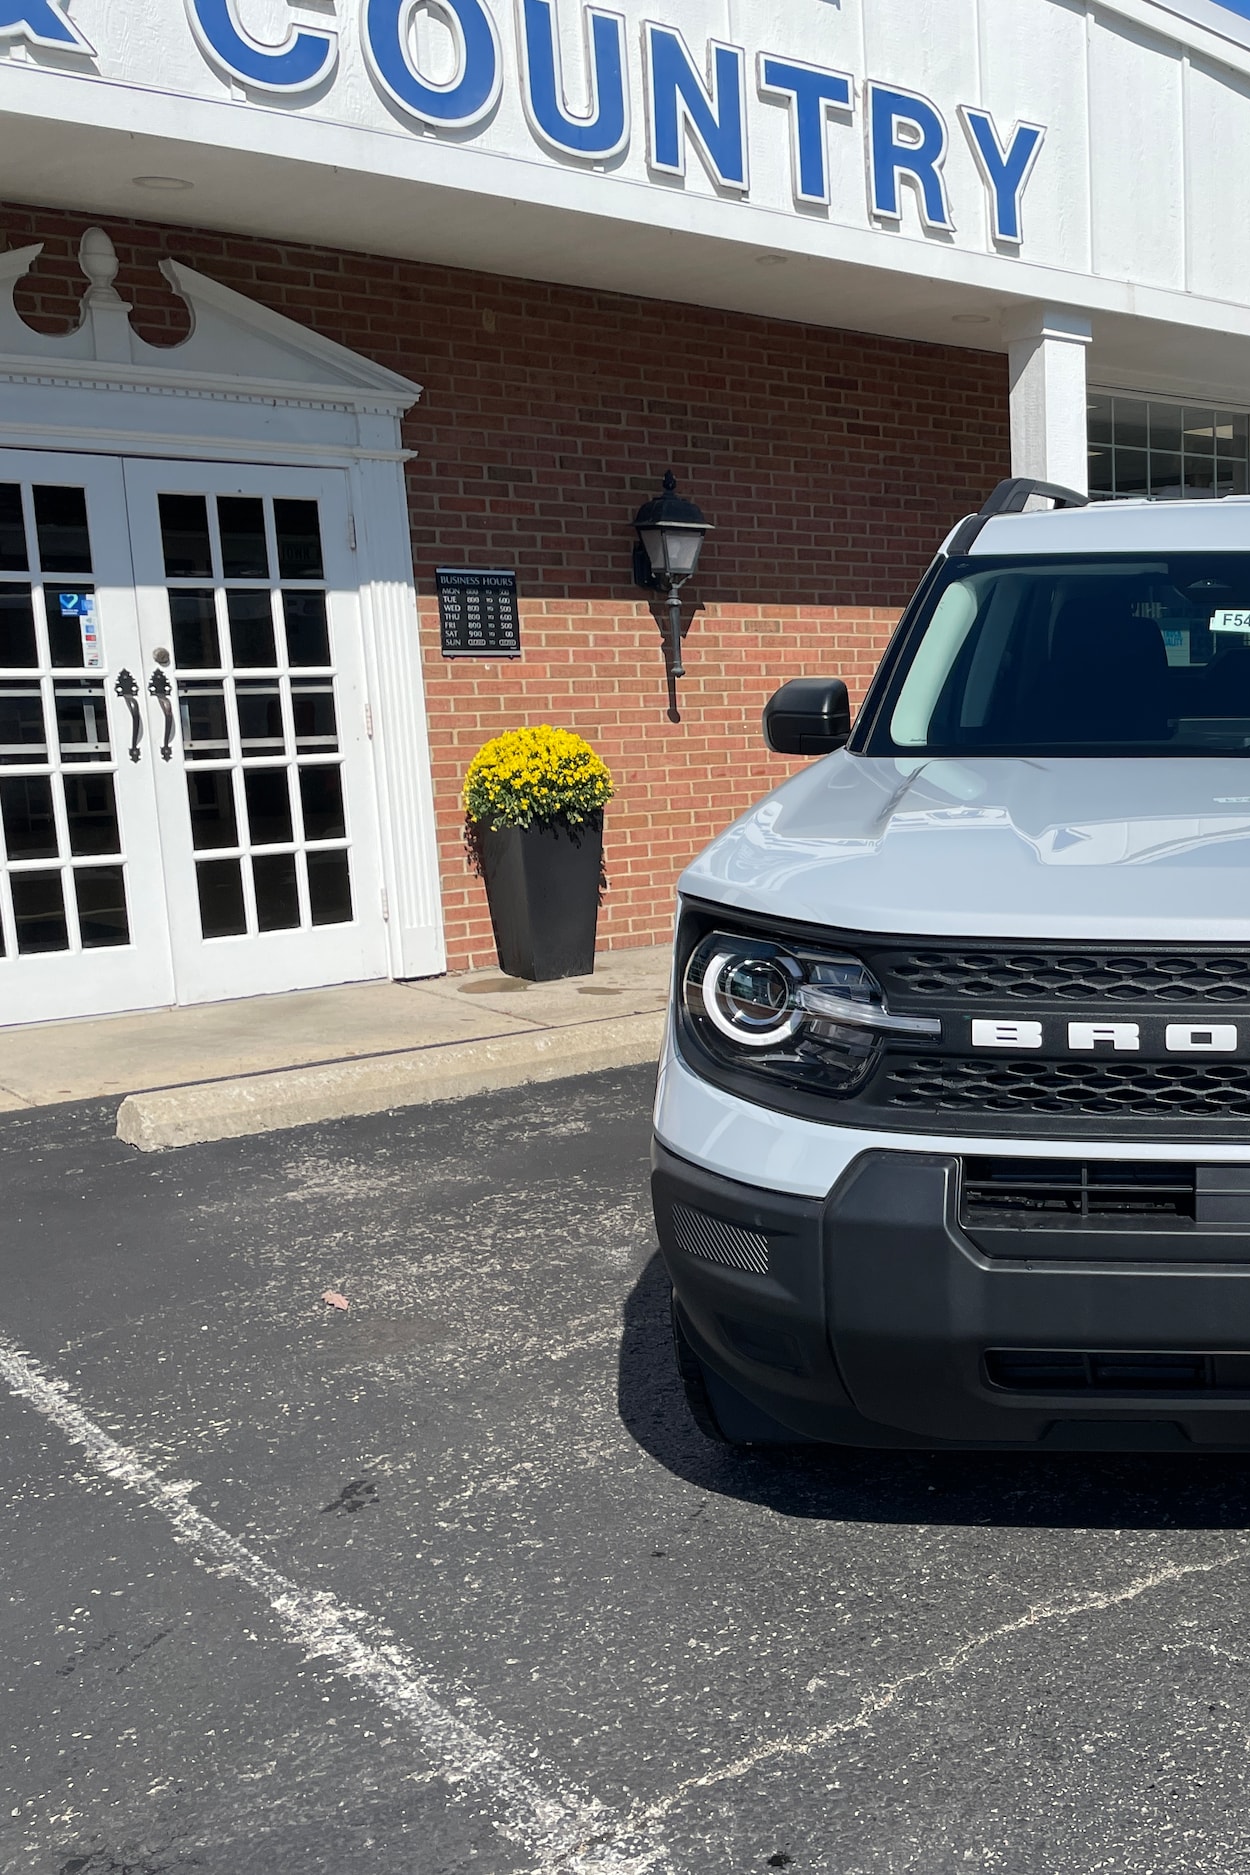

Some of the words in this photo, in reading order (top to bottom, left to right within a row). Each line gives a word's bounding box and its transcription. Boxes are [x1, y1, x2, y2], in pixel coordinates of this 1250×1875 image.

[185, 0, 1047, 245] COUNTRY
[440, 576, 480, 585] BUSINESS
[482, 577, 513, 586] HOURS
